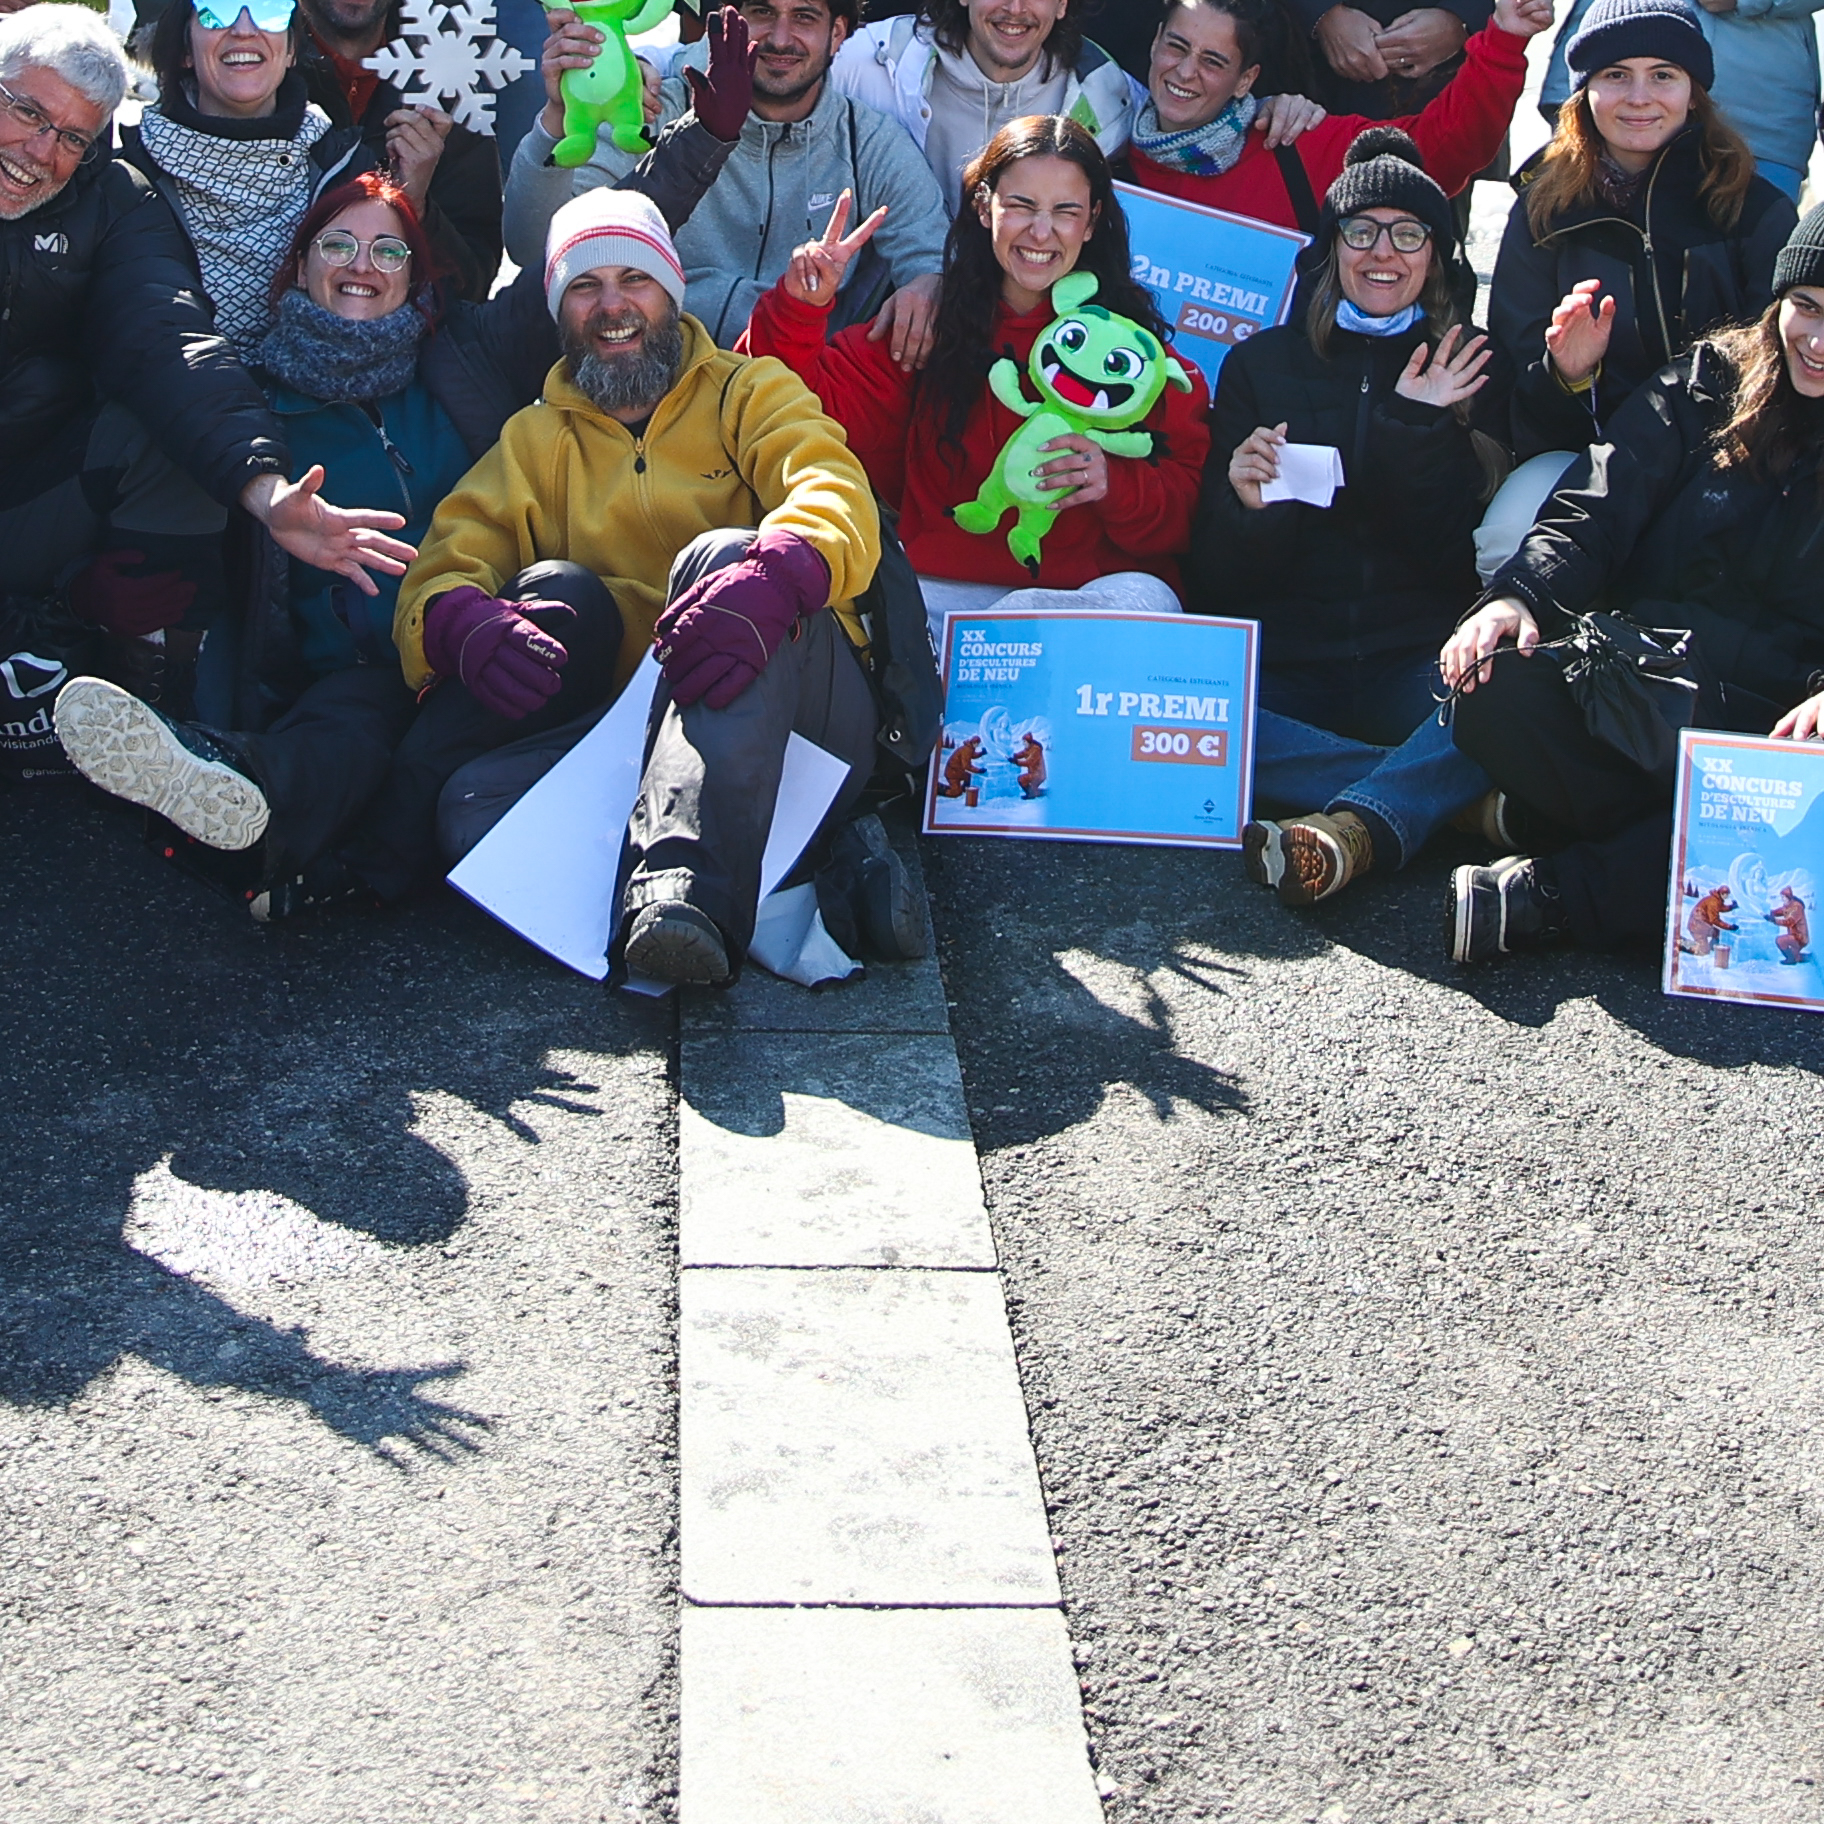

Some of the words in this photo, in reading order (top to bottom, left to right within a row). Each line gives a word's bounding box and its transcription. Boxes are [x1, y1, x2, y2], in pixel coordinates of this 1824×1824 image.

[809, 193, 834, 206] NIKE
[1129, 254, 1171, 289] 2n
[1173, 271, 1270, 316] PREMI
[1182, 308, 1228, 335] 200
[1231, 322, 1253, 341] €
[961, 629, 986, 643] XX
[960, 642, 1043, 657] CONCURS
[958, 658, 1037, 668] D'ESCULTURES
[957, 668, 981, 682] DE
[982, 668, 1020, 682] NEU
[1075, 683, 1114, 716] 1r
[1117, 690, 1231, 723] PREMI
[1139, 730, 1190, 756] 300
[1195, 733, 1221, 758] €
[1702, 756, 1734, 774] XX
[1701, 774, 1804, 797] CONCURS
[1700, 791, 1796, 810] D'ESCULTURES
[1699, 802, 1730, 820] DE
[1731, 806, 1776, 824] NEU
